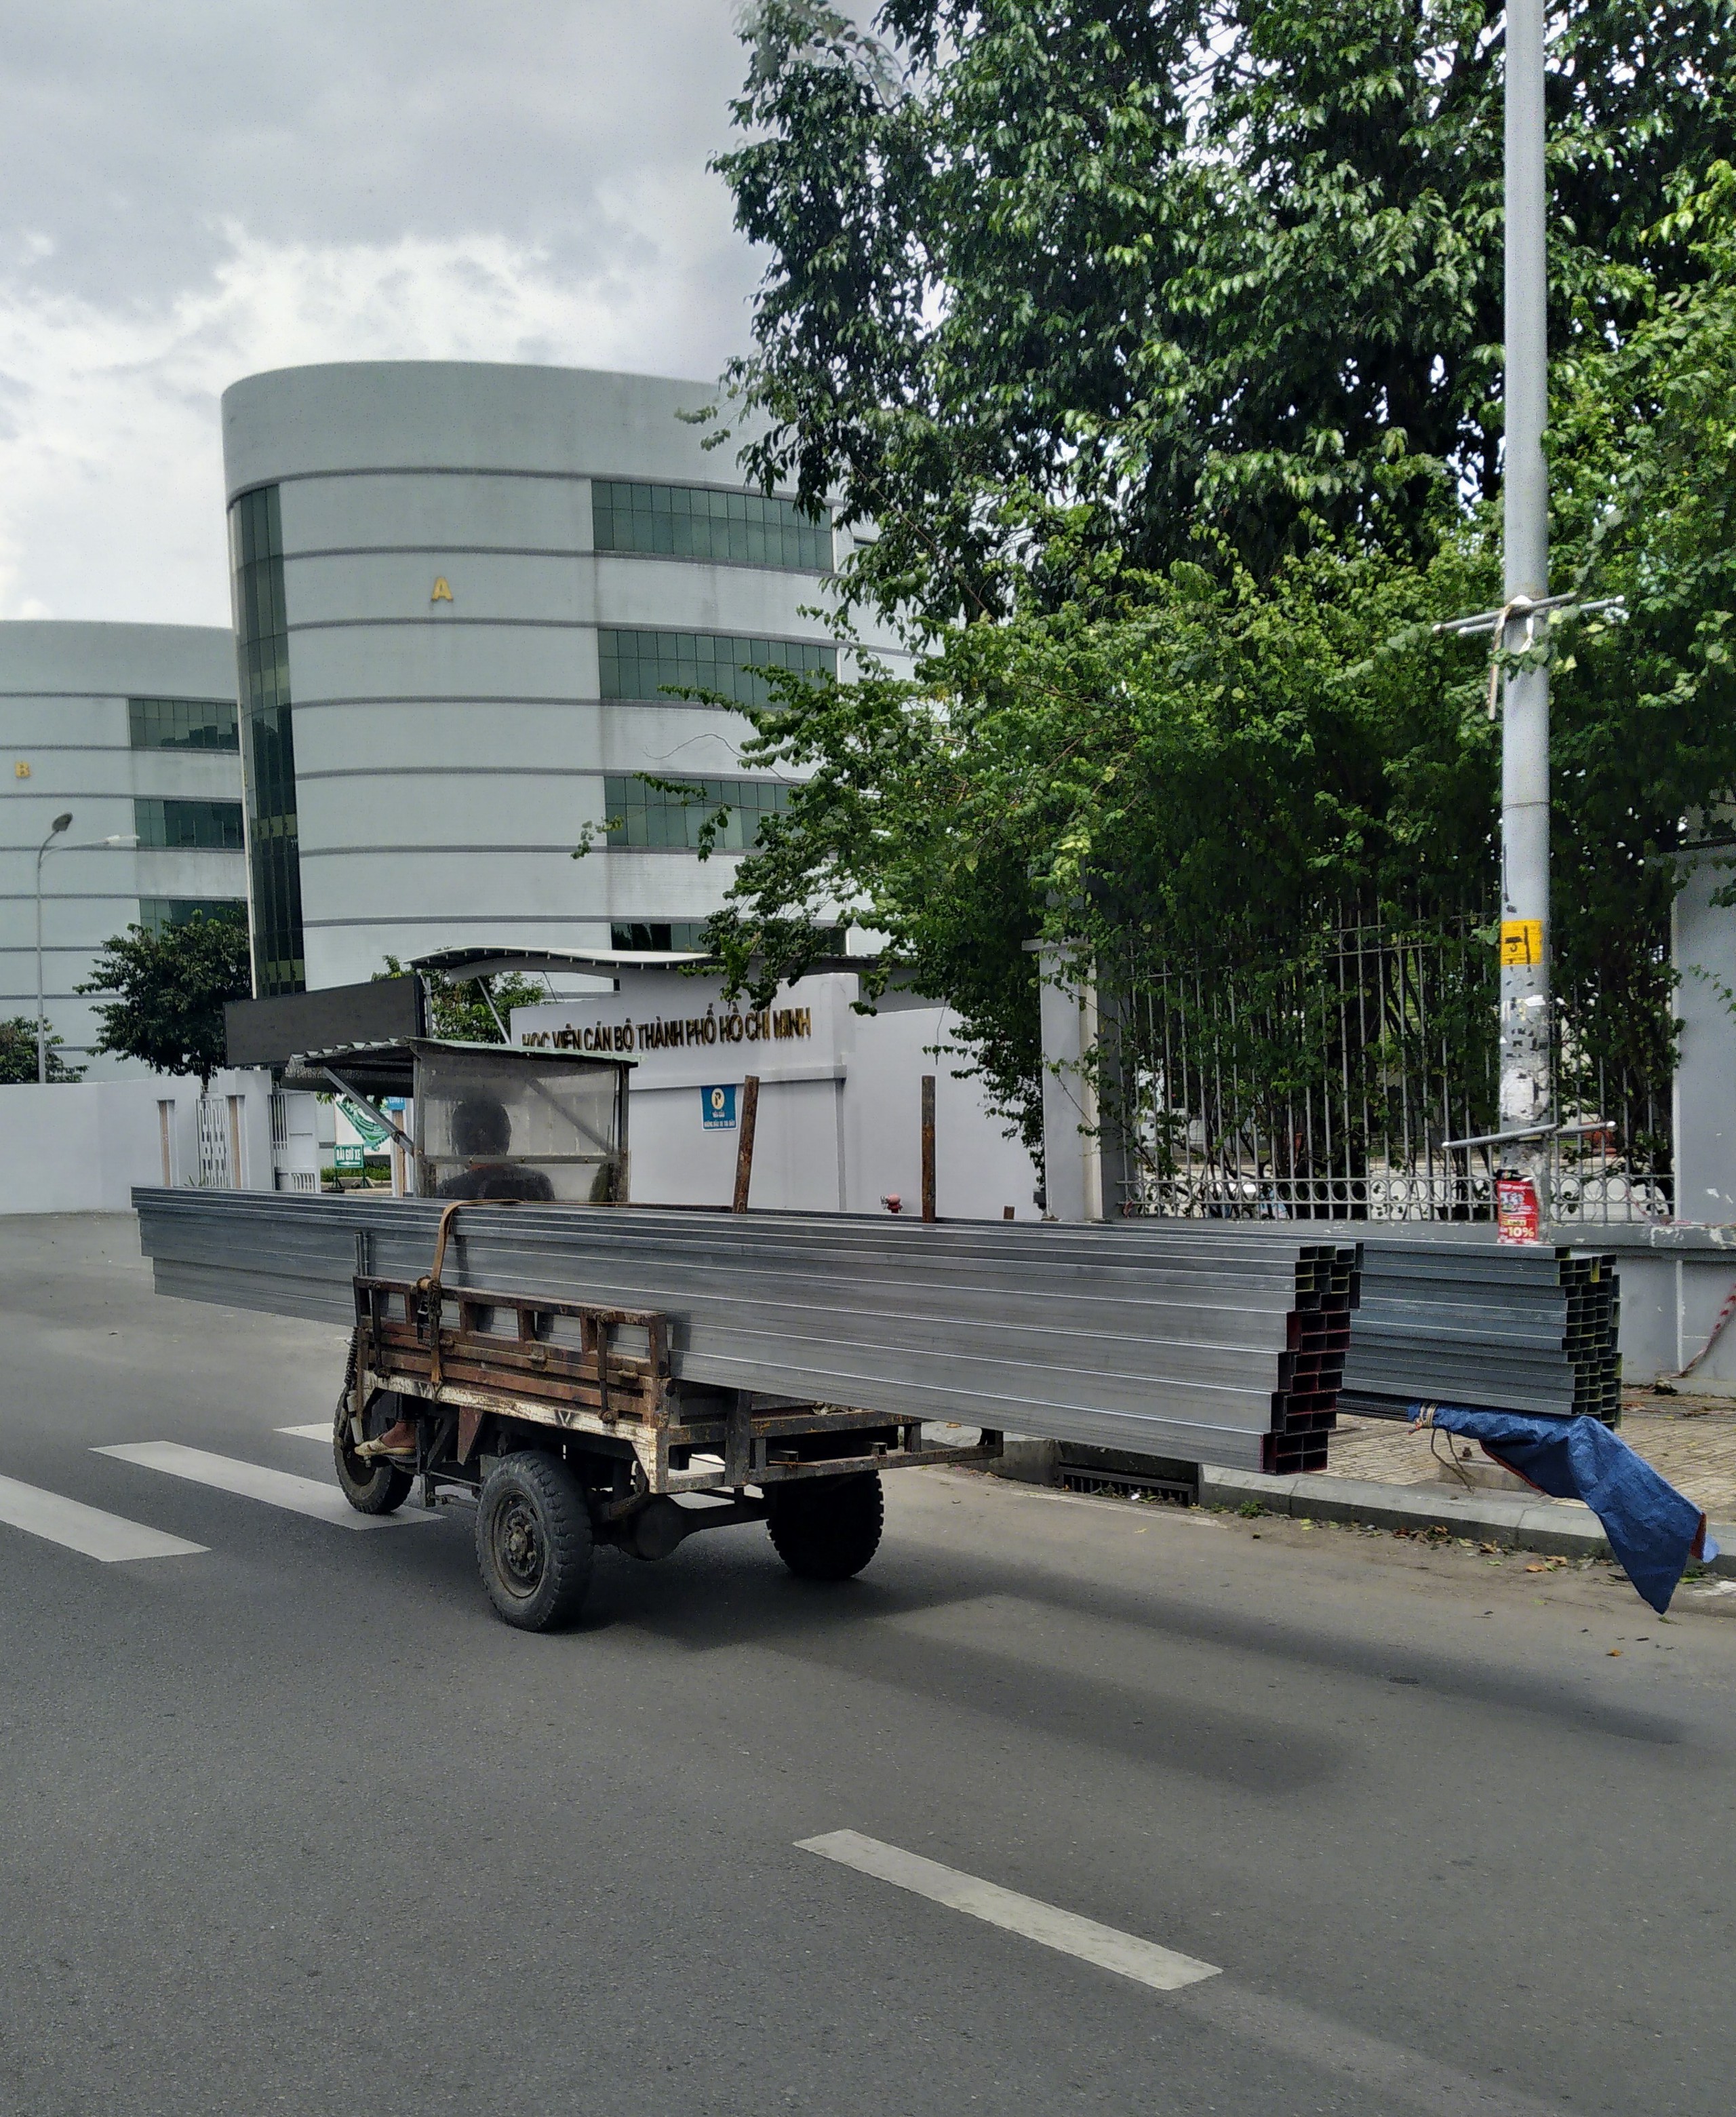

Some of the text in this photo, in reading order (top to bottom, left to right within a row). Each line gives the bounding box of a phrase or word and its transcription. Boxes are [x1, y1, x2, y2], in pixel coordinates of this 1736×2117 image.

[431, 576, 454, 602] A
[584, 1020, 613, 1051] CÁN
[614, 1017, 635, 1053] BỘ
[636, 1015, 684, 1051] THÀNH
[686, 1003, 717, 1047] PHỐ
[719, 1001, 744, 1044] HỒ
[745, 1005, 771, 1041] CHÍ
[772, 1007, 812, 1040] MINH
[1507, 1226, 1535, 1238] 10%
